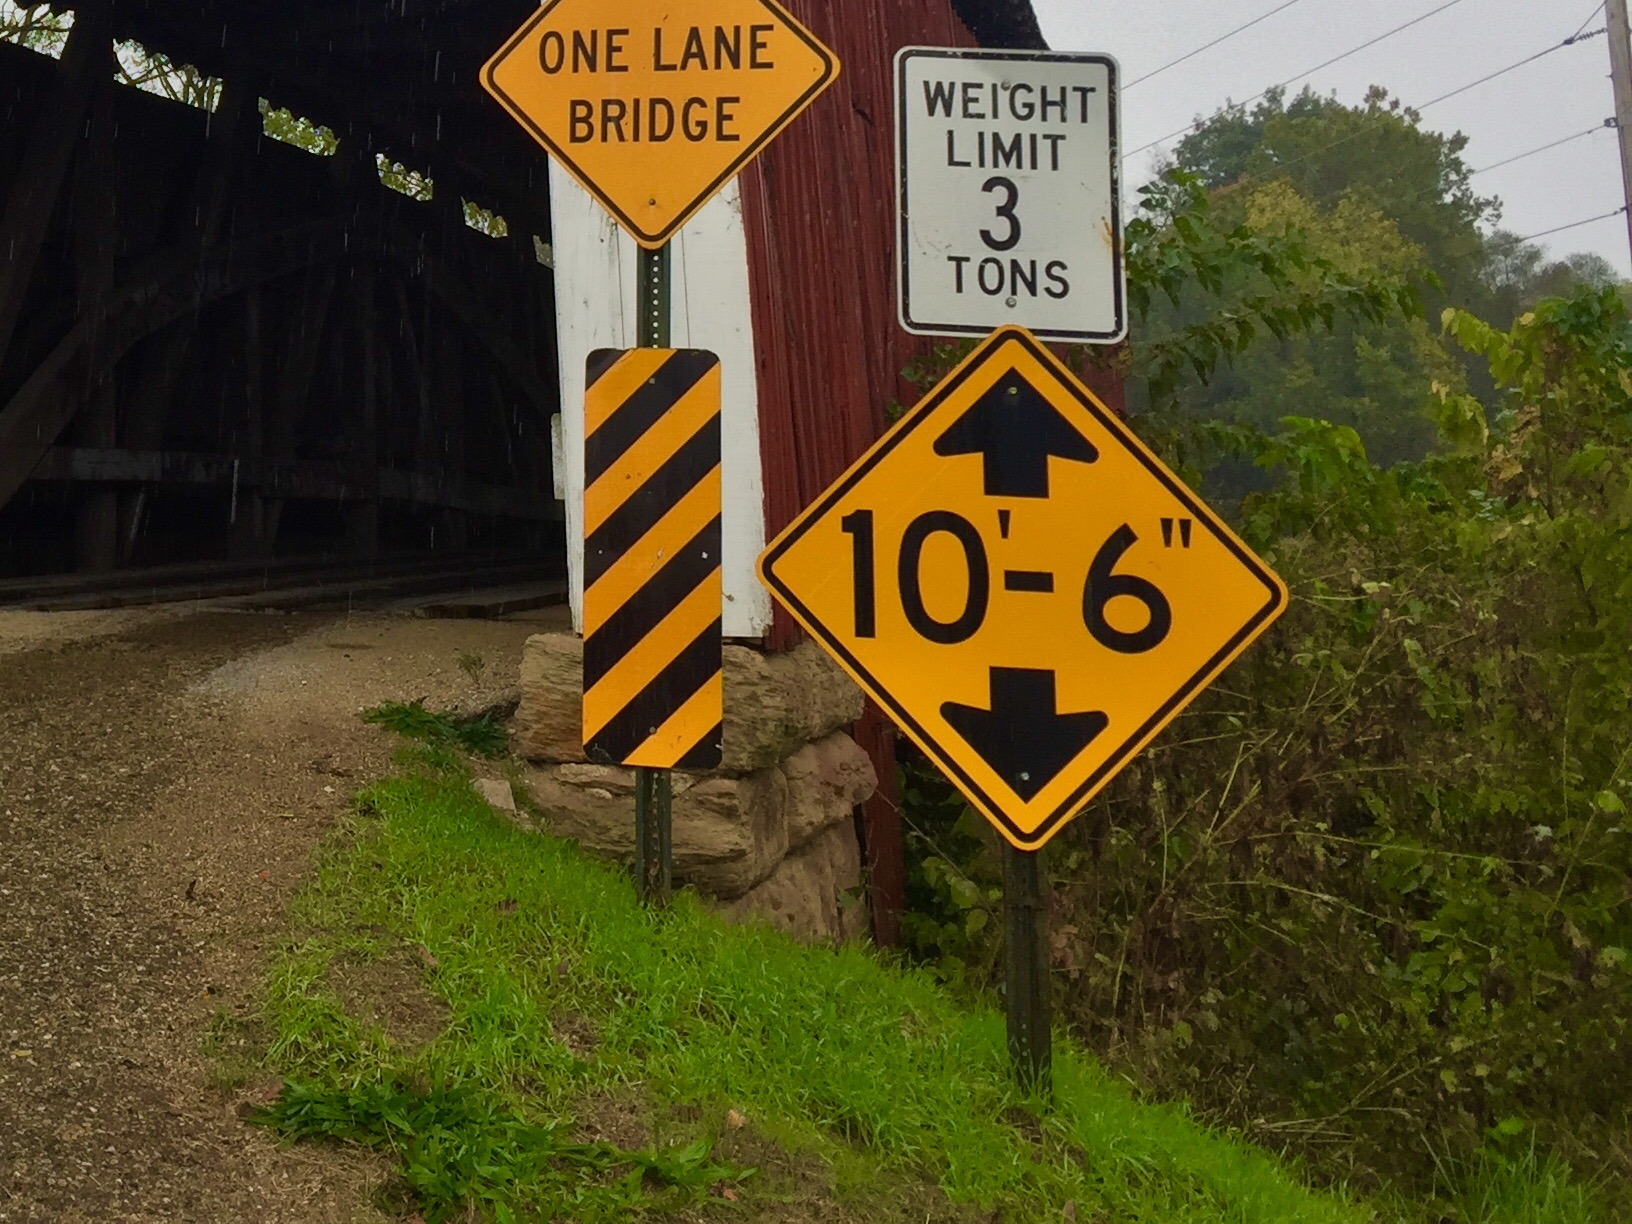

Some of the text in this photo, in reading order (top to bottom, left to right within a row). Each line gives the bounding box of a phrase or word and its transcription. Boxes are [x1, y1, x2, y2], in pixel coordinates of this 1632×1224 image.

[538, 24, 775, 73] ONE LANE
[569, 96, 742, 144] BRIDGE
[922, 80, 1097, 125] WEIGHT
[946, 129, 1067, 172] LIMIT
[978, 176, 1023, 252] 3
[946, 256, 1070, 300] TONS
